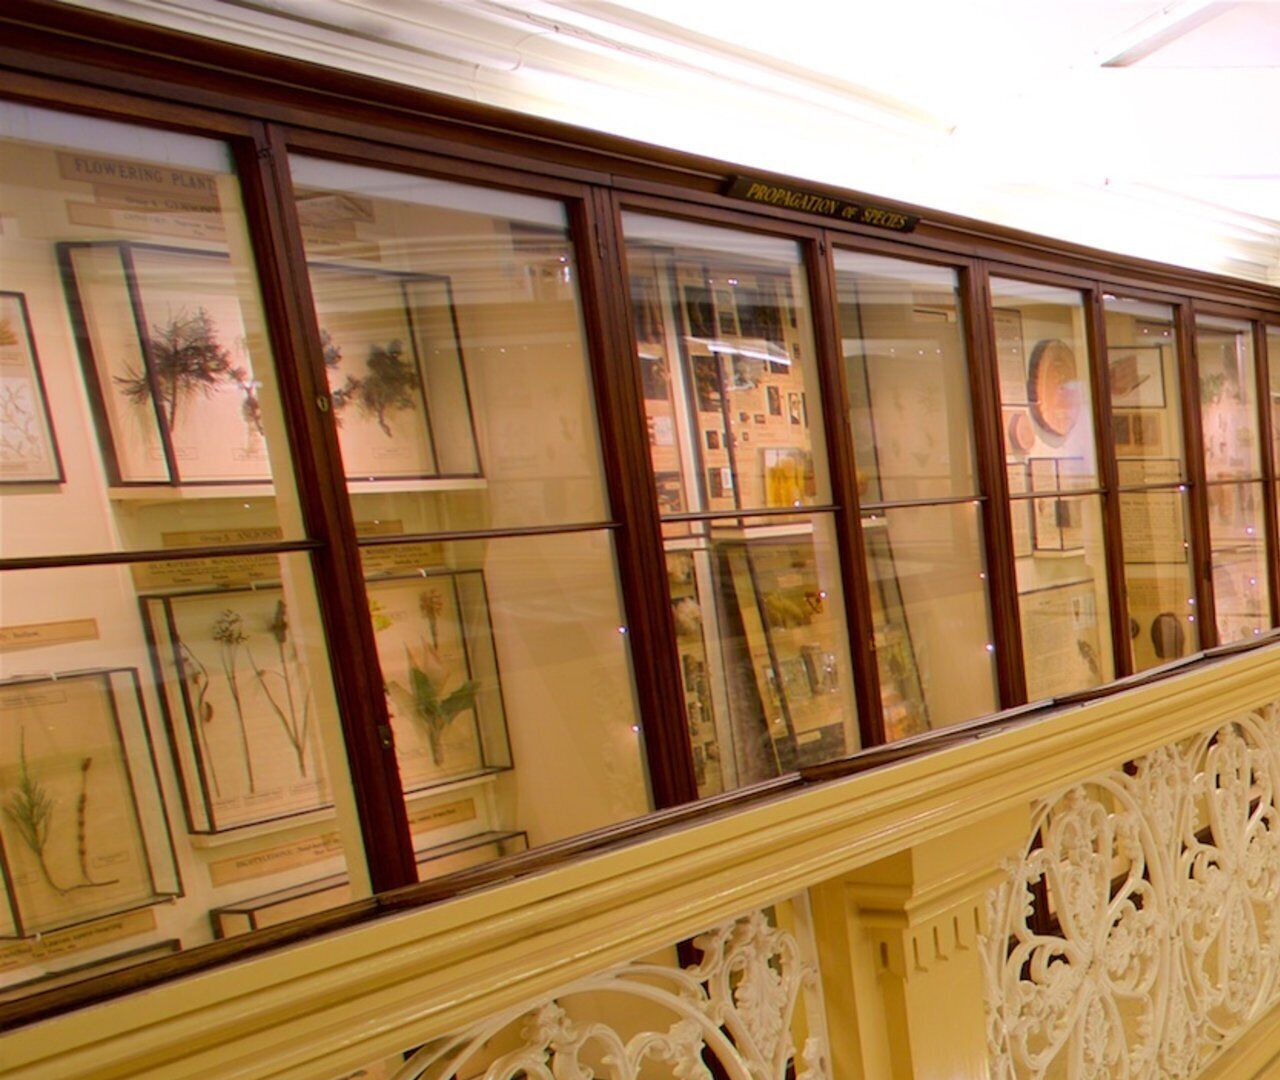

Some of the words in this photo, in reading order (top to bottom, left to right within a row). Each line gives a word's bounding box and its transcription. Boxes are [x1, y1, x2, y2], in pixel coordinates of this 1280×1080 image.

[74, 159, 163, 183] FLOWERING
[746, 183, 839, 214] PROPAGATION
[861, 207, 908, 228] SPECIES
